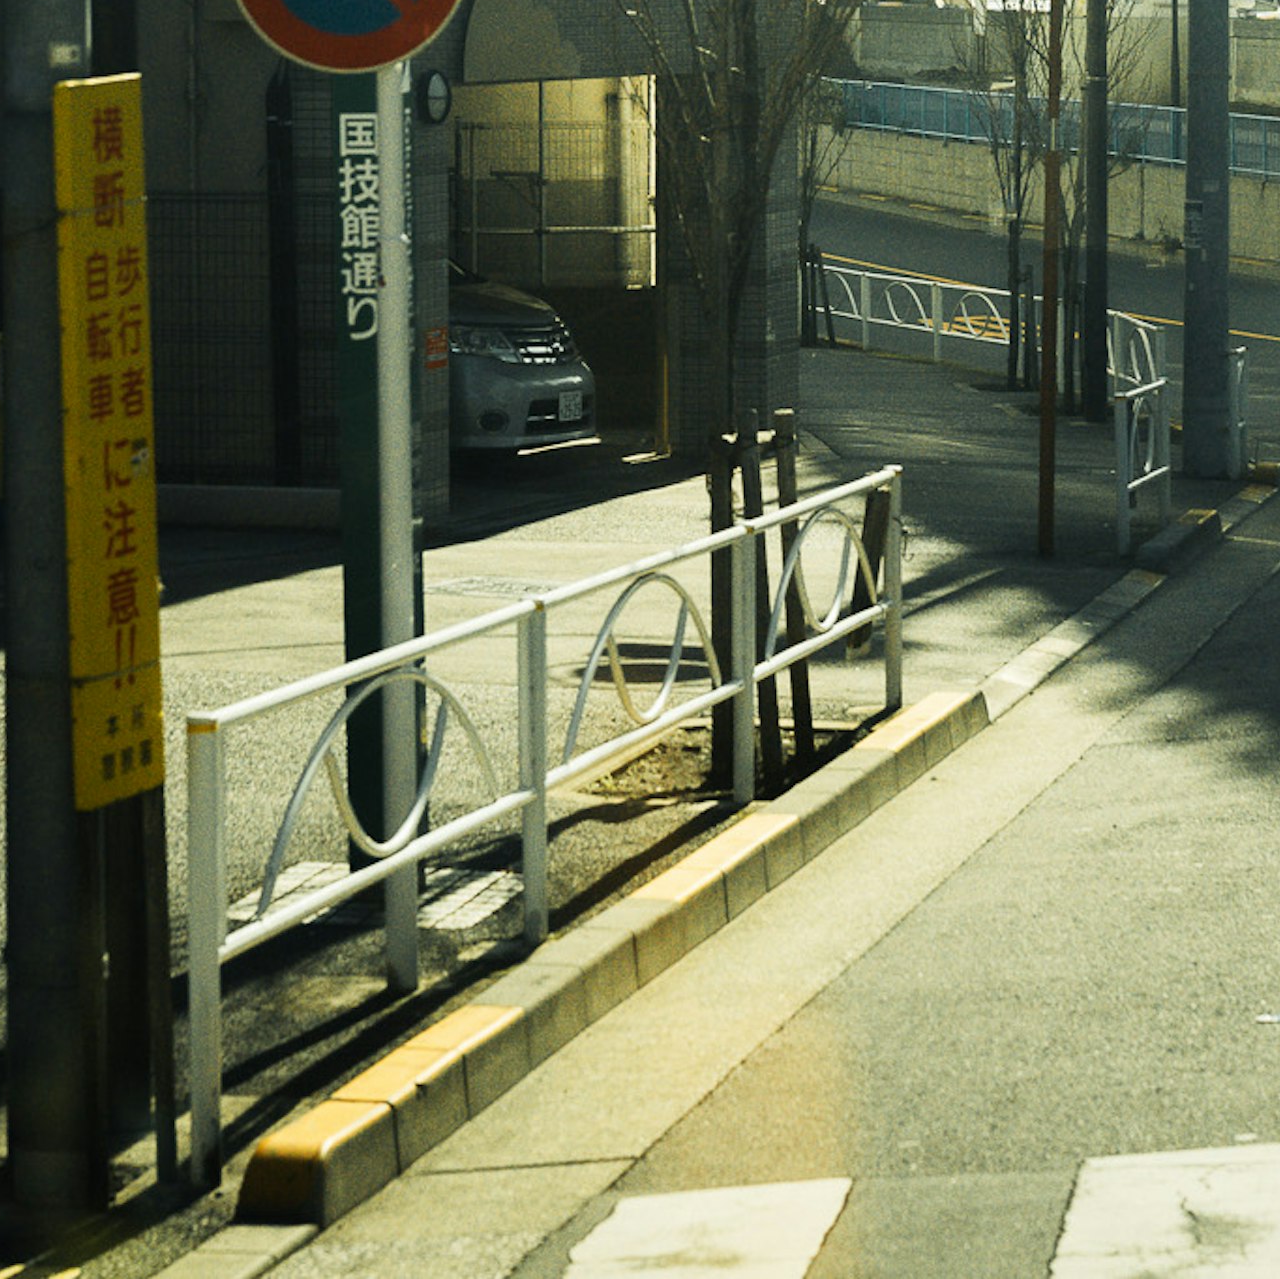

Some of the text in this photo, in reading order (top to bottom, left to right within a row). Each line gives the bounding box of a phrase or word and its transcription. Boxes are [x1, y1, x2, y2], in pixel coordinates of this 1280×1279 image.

[91, 106, 125, 229] 横断
[338, 112, 380, 342] 国技館通り
[84, 250, 114, 426] 自転車
[114, 246, 146, 418] 歩行者
